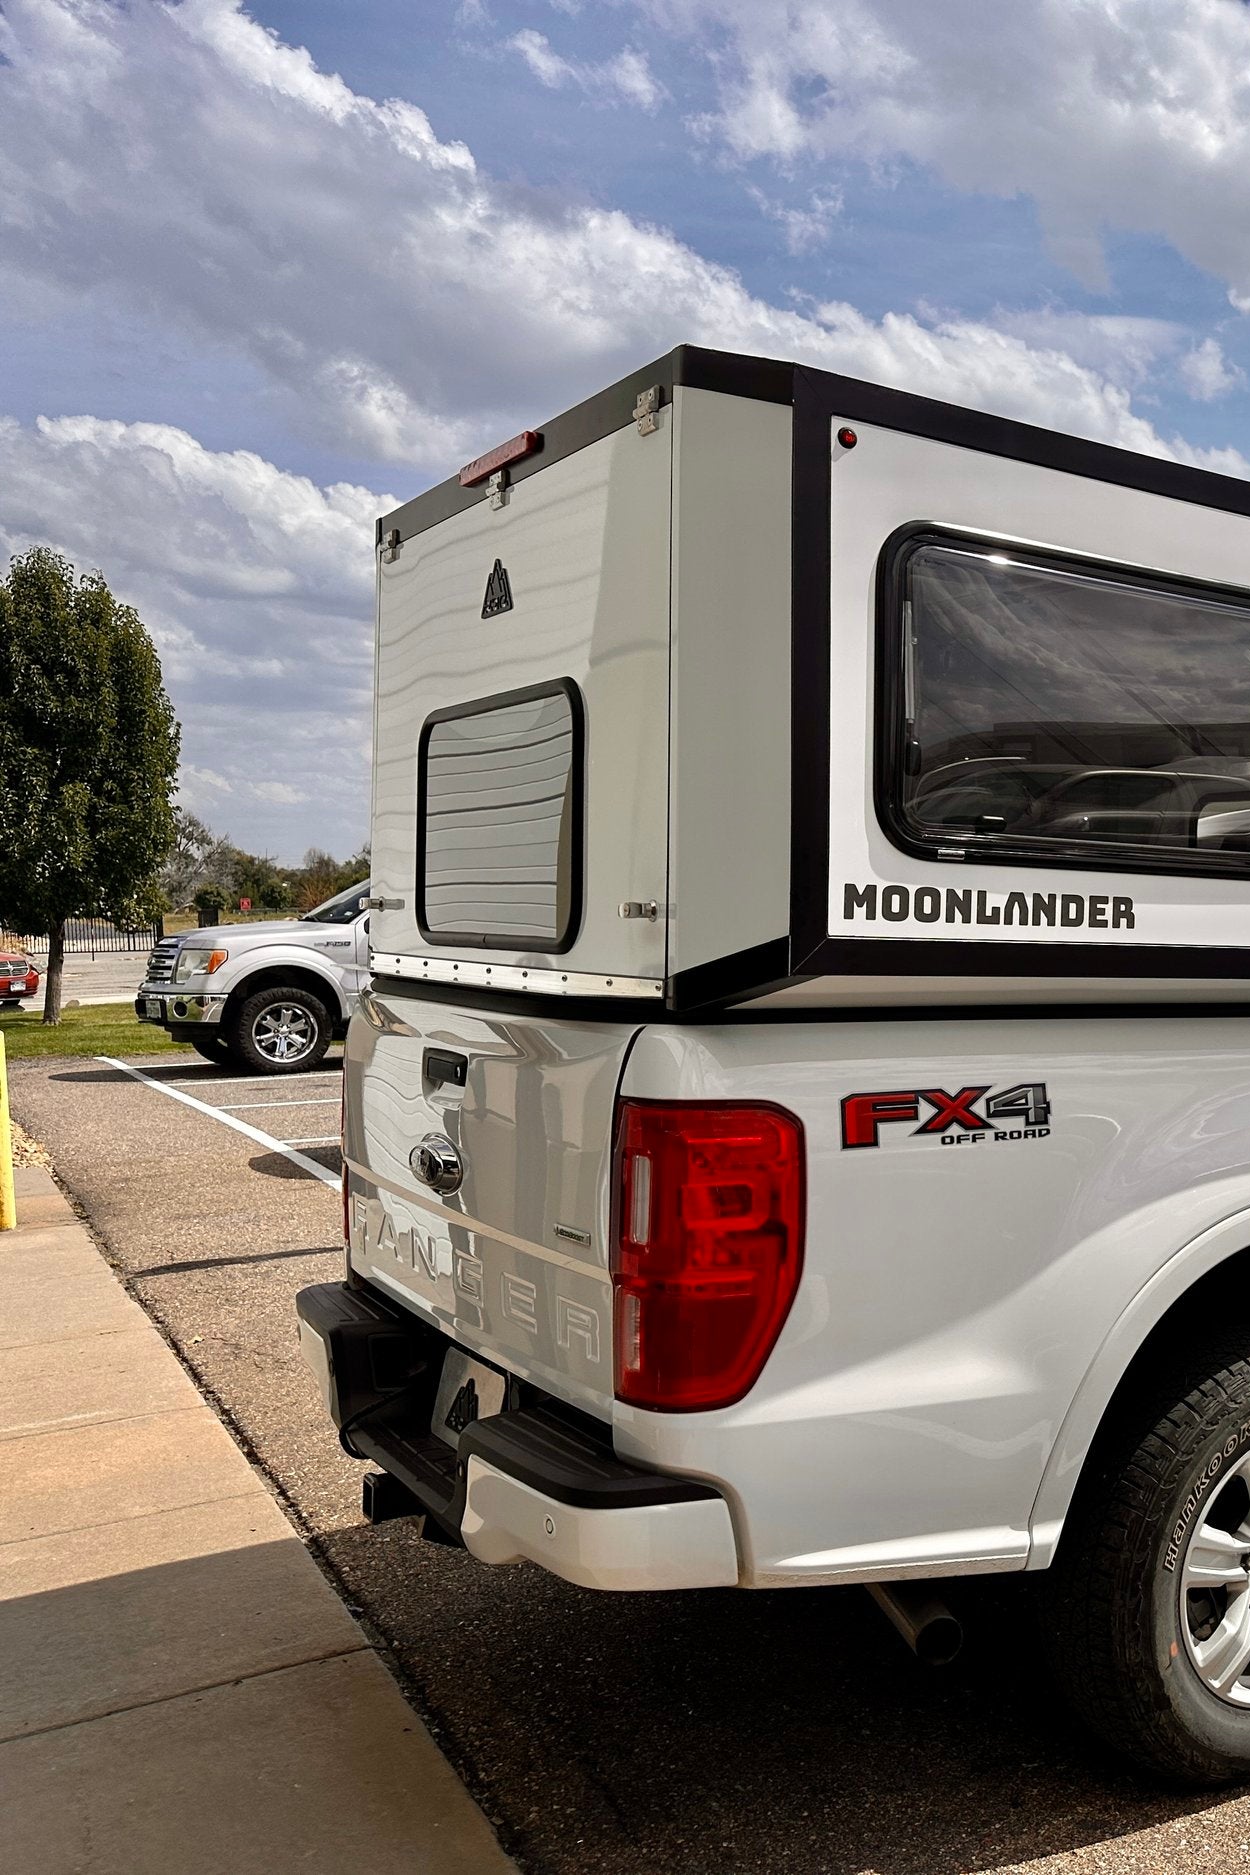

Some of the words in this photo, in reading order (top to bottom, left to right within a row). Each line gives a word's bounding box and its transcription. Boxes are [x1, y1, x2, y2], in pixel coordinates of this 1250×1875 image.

[843, 882, 1136, 930] MOONLANDER
[840, 1082, 1051, 1150] FX4
[940, 1132, 986, 1146] OFF
[993, 1127, 1051, 1142] ROAD
[351, 1191, 601, 1364] RANGER
